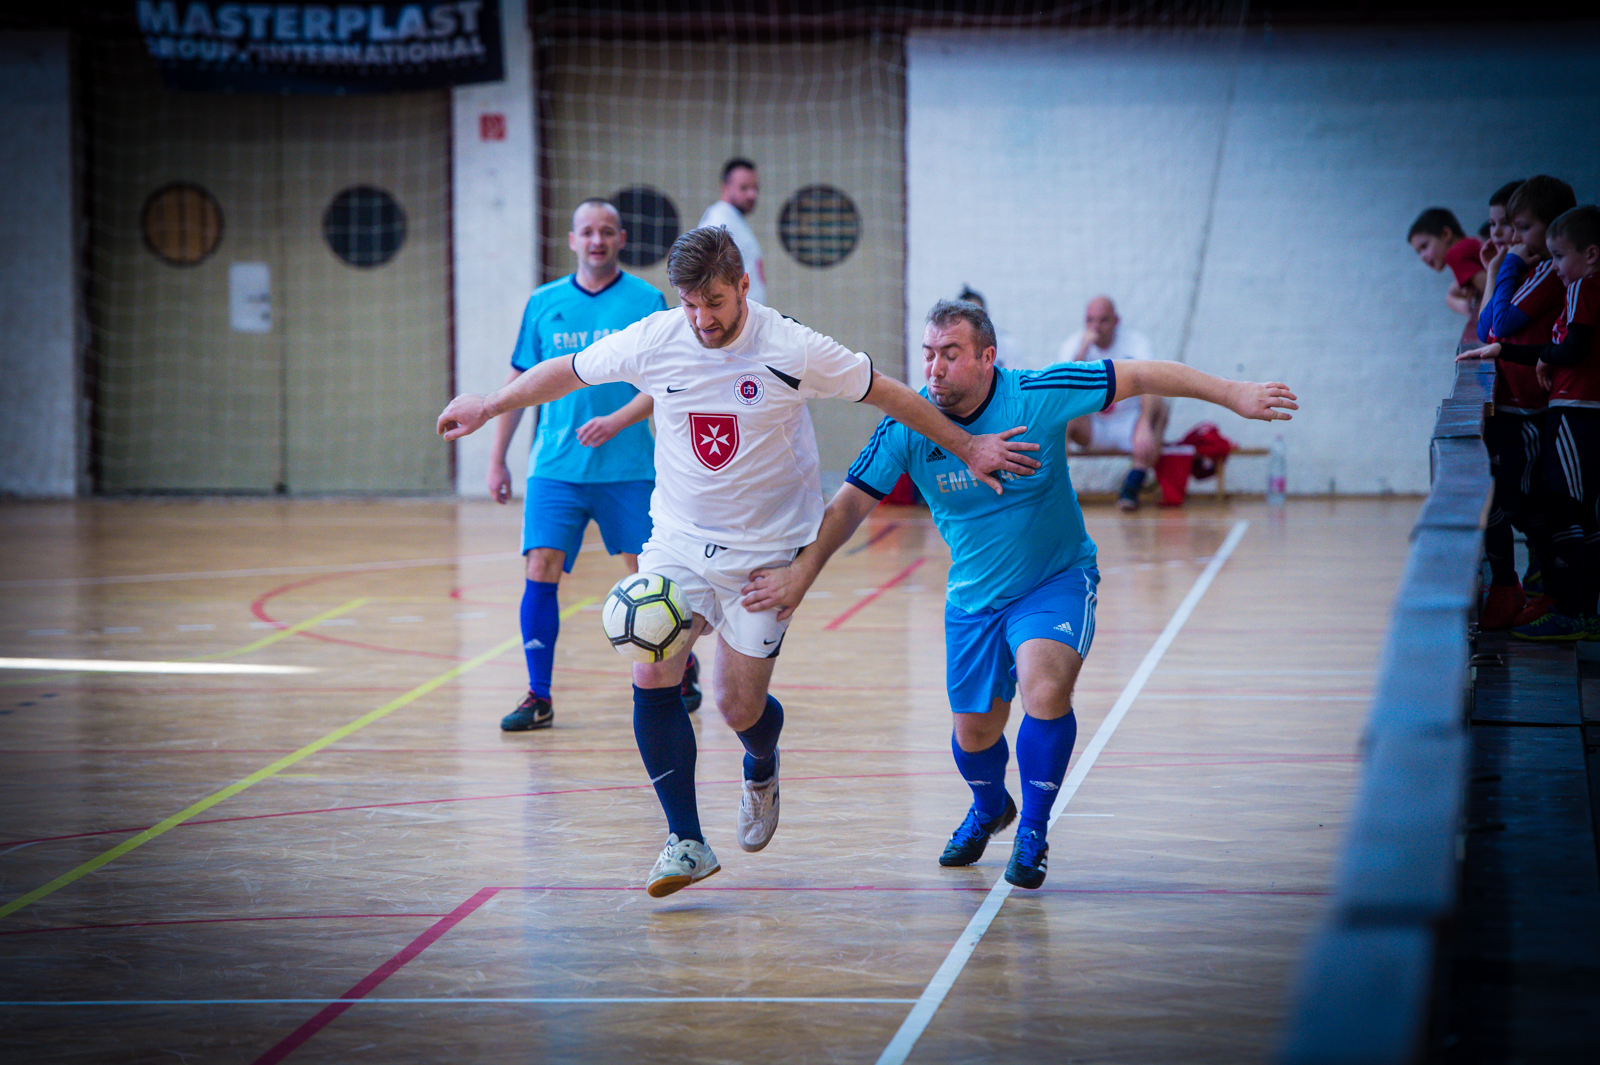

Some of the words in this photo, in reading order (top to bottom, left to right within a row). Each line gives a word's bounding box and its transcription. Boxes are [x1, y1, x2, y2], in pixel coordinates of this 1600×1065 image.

[136, 0, 484, 40] MASTERPLAST
[553, 331, 588, 349] EMY
[735, 375, 763, 389] VIDEOTON
[935, 468, 979, 494] EMY
